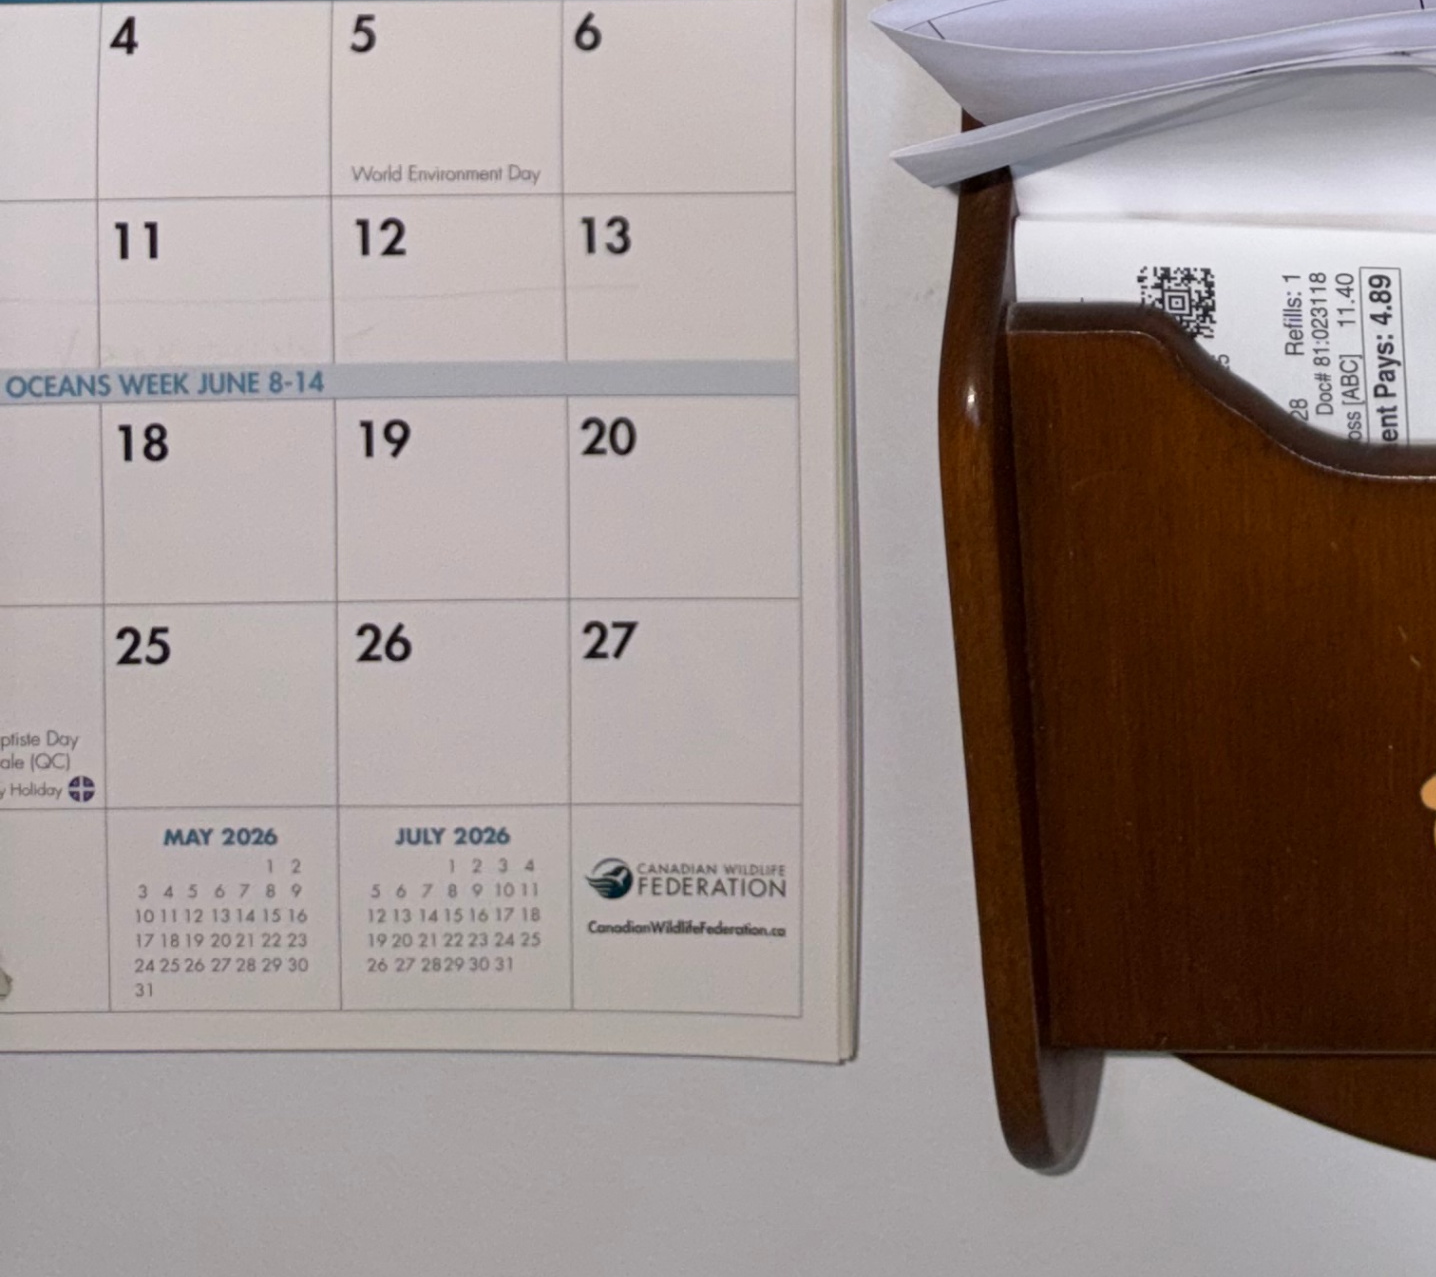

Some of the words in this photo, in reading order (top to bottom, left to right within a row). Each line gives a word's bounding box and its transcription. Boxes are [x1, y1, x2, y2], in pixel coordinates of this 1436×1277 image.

[110, 17, 138, 54] 4
[351, 15, 375, 53] 5
[575, 13, 601, 51] 6
[352, 164, 402, 182] World
[408, 165, 502, 182] Environment
[508, 164, 541, 185] Day
[115, 222, 157, 259] 11
[356, 218, 406, 256] 12
[582, 216, 630, 254] 13
[1335, 273, 1355, 327] 11.40
[1368, 275, 1392, 325] 4.89
[1283, 292, 1304, 355] Refills:
[1309, 273, 1331, 367] 81:023118
[1342, 353, 1365, 407] [ABC]
[1373, 335, 1401, 398] Pays:
[6, 374, 111, 398] OCEANS
[119, 373, 189, 395] WEEK
[198, 372, 259, 395] JUNE
[269, 371, 324, 394] 8-14
[1314, 373, 1334, 415] Doc#
[119, 423, 168, 462] 18
[360, 420, 410, 457] 19
[581, 417, 636, 456] 20
[117, 627, 170, 665] 25
[357, 623, 411, 662] 26
[583, 621, 638, 659] 27
[46, 730, 79, 751] Day
[30, 753, 70, 772] (QC)
[10, 782, 62, 799] Holiday
[164, 828, 213, 846] MAY
[222, 828, 278, 846] 2026
[395, 828, 446, 845] JULY
[454, 827, 510, 845] 2026
[267, 859, 272, 873] 1
[292, 858, 300, 874] 2
[637, 863, 717, 875] CANADIAN
[724, 864, 785, 877] WILDLIFE
[138, 884, 147, 899] 3
[164, 885, 173, 898] 4
[188, 884, 197, 899] 5
[215, 884, 225, 898] 6
[240, 884, 250, 898] 7
[266, 884, 275, 898] 8
[291, 883, 302, 898] 9
[638, 877, 786, 897] FEDERATION
